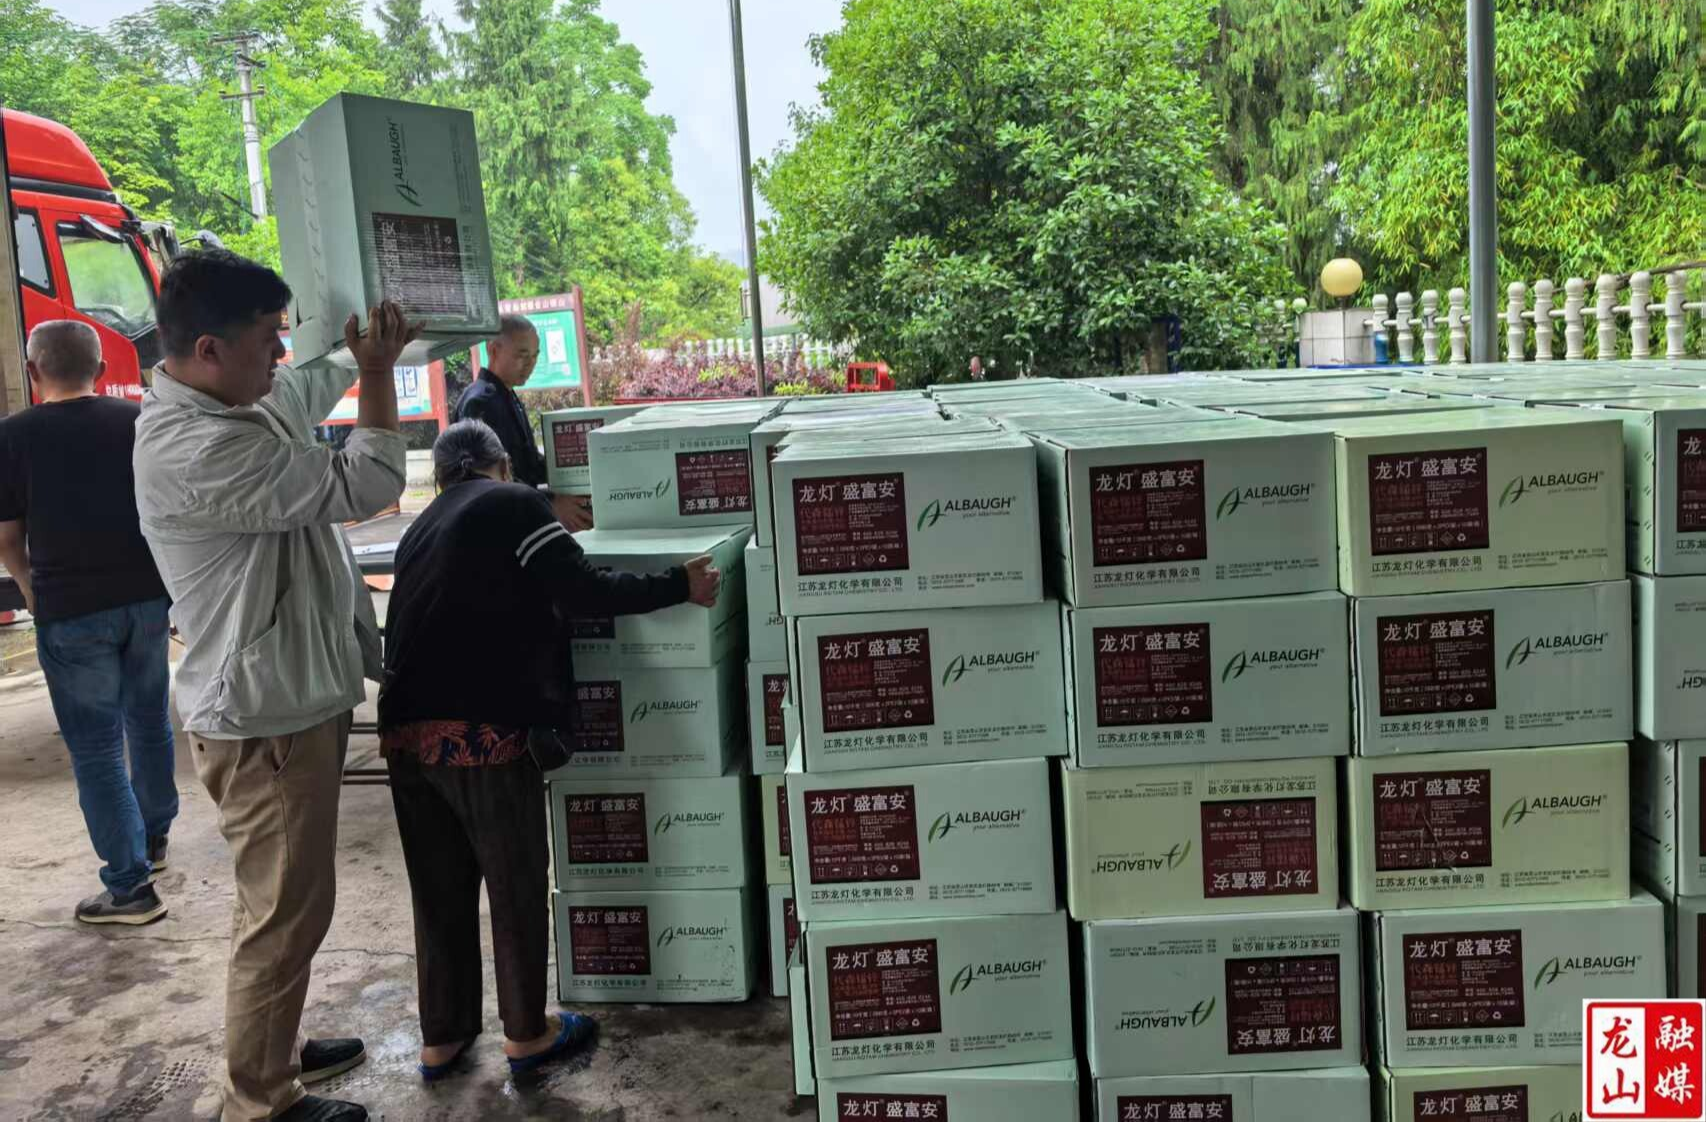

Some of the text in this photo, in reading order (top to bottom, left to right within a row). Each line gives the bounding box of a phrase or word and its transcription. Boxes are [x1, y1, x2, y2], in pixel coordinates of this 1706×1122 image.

[1375, 455, 1478, 480] 龙灯 盛富安
[1096, 469, 1196, 492] 龙灯 盛富安
[1528, 472, 1599, 488] ALBAUGH
[800, 480, 896, 503] 龙灯 盛富安
[1243, 484, 1311, 500] ALBAUGH
[944, 497, 1011, 512] ALBAUGH
[1372, 556, 1482, 573] 江苏龙灯化学有限公司
[1093, 566, 1200, 584] 江苏龙灯化学有限公司
[798, 577, 903, 592] 江苏龙灯化学有限公司
[1384, 617, 1485, 642] 龙灯 盛富安
[824, 636, 921, 660] 龙灯 盛富安
[1100, 631, 1201, 653] 龙灯 盛富安
[1534, 633, 1604, 649] ALBAUGH
[969, 652, 1035, 667] ALBAUGH
[1250, 648, 1320, 664] ALBAUGH
[650, 701, 699, 710] ALBAUGH
[1380, 716, 1488, 733] 江苏龙灯化学有限公司
[824, 732, 928, 749] 江苏龙灯化学有限公司
[1097, 729, 1205, 744] 江苏龙灯化学有限公司
[1208, 780, 1317, 795] 江苏龙灯化学有限公司
[1380, 777, 1481, 799] 龙灯 盛富安
[811, 792, 906, 814] 龙灯 盛富安
[1531, 795, 1601, 810] ALBAUGH
[674, 812, 721, 822] ALBAUGH
[955, 810, 1021, 824] ALBAUGH
[1096, 858, 1162, 873] ALBAUGH
[1213, 870, 1312, 891] 龙灯 盛富安
[1375, 873, 1485, 888] 江苏龙灯化学有限公司
[811, 886, 914, 900] 江苏龙灯化学有限公司
[574, 911, 641, 924] 龙灯 盛富安
[676, 927, 724, 936] ALBAUGH
[1232, 938, 1340, 953] 江苏龙灯化学有限公司
[1410, 937, 1512, 959] 龙灯 盛富安
[832, 947, 928, 970] 龙灯 盛富安
[1564, 956, 1636, 969] ALBAUGH
[976, 960, 1042, 975] ALBAUGH
[1121, 1015, 1187, 1029] ALBAUGH
[1238, 1025, 1335, 1047] 龙灯 盛富安
[1406, 1033, 1518, 1047] 江苏龙灯化学有限公司
[832, 1040, 935, 1056] 江苏龙灯化学有限公司
[844, 1099, 938, 1118] 龙灯 盛富安
[1124, 1101, 1224, 1119] 龙灯 盛富安
[1420, 1093, 1519, 1115] 龙灯 盛富安
